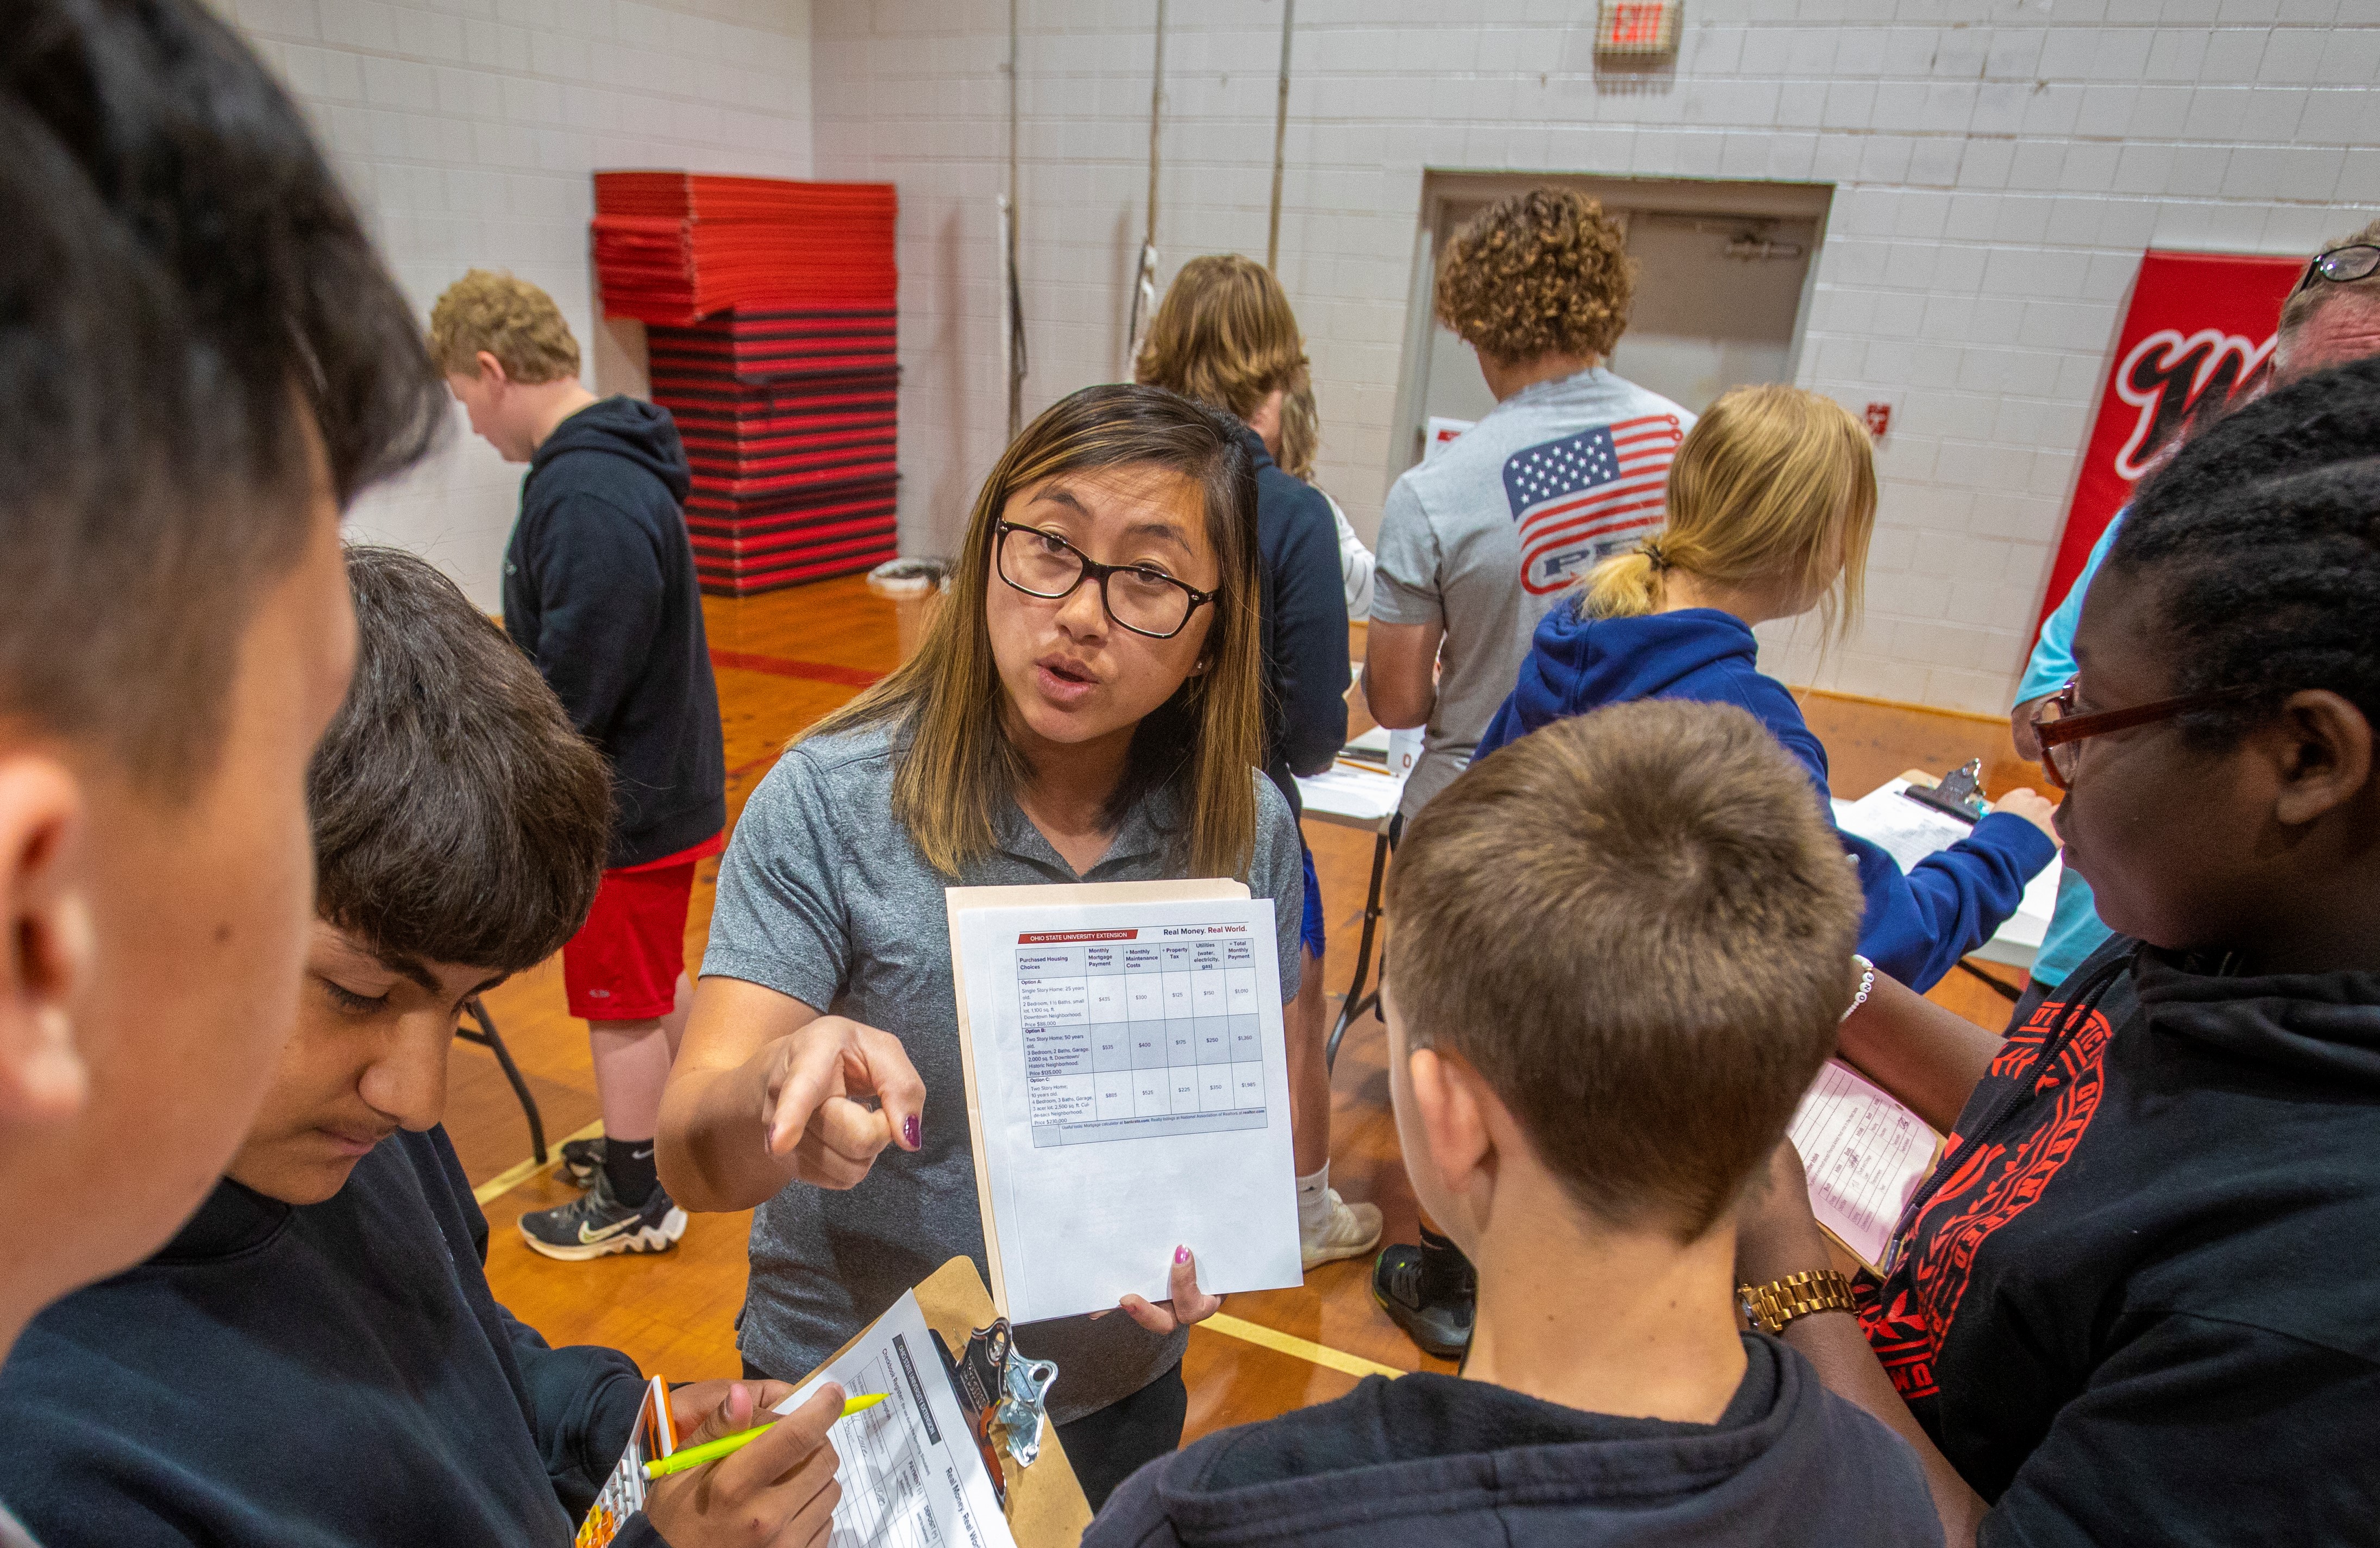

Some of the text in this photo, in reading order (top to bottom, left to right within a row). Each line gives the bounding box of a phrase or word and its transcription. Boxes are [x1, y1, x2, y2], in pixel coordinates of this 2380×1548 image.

[1859, 974, 1872, 1000] ONE
[882, 1348, 895, 1378] Checkbook
[892, 1377, 904, 1403] Register:
[903, 1358, 912, 1374] STATE
[909, 1374, 923, 1404] UNIVERSITY
[920, 1403, 935, 1434] EXTENSION
[908, 1461, 920, 1487] PAYMENT
[924, 1505, 935, 1530] DEPOSIT
[946, 1467, 956, 1486] Real
[951, 1485, 966, 1514] Money.
[962, 1512, 973, 1531] Real
